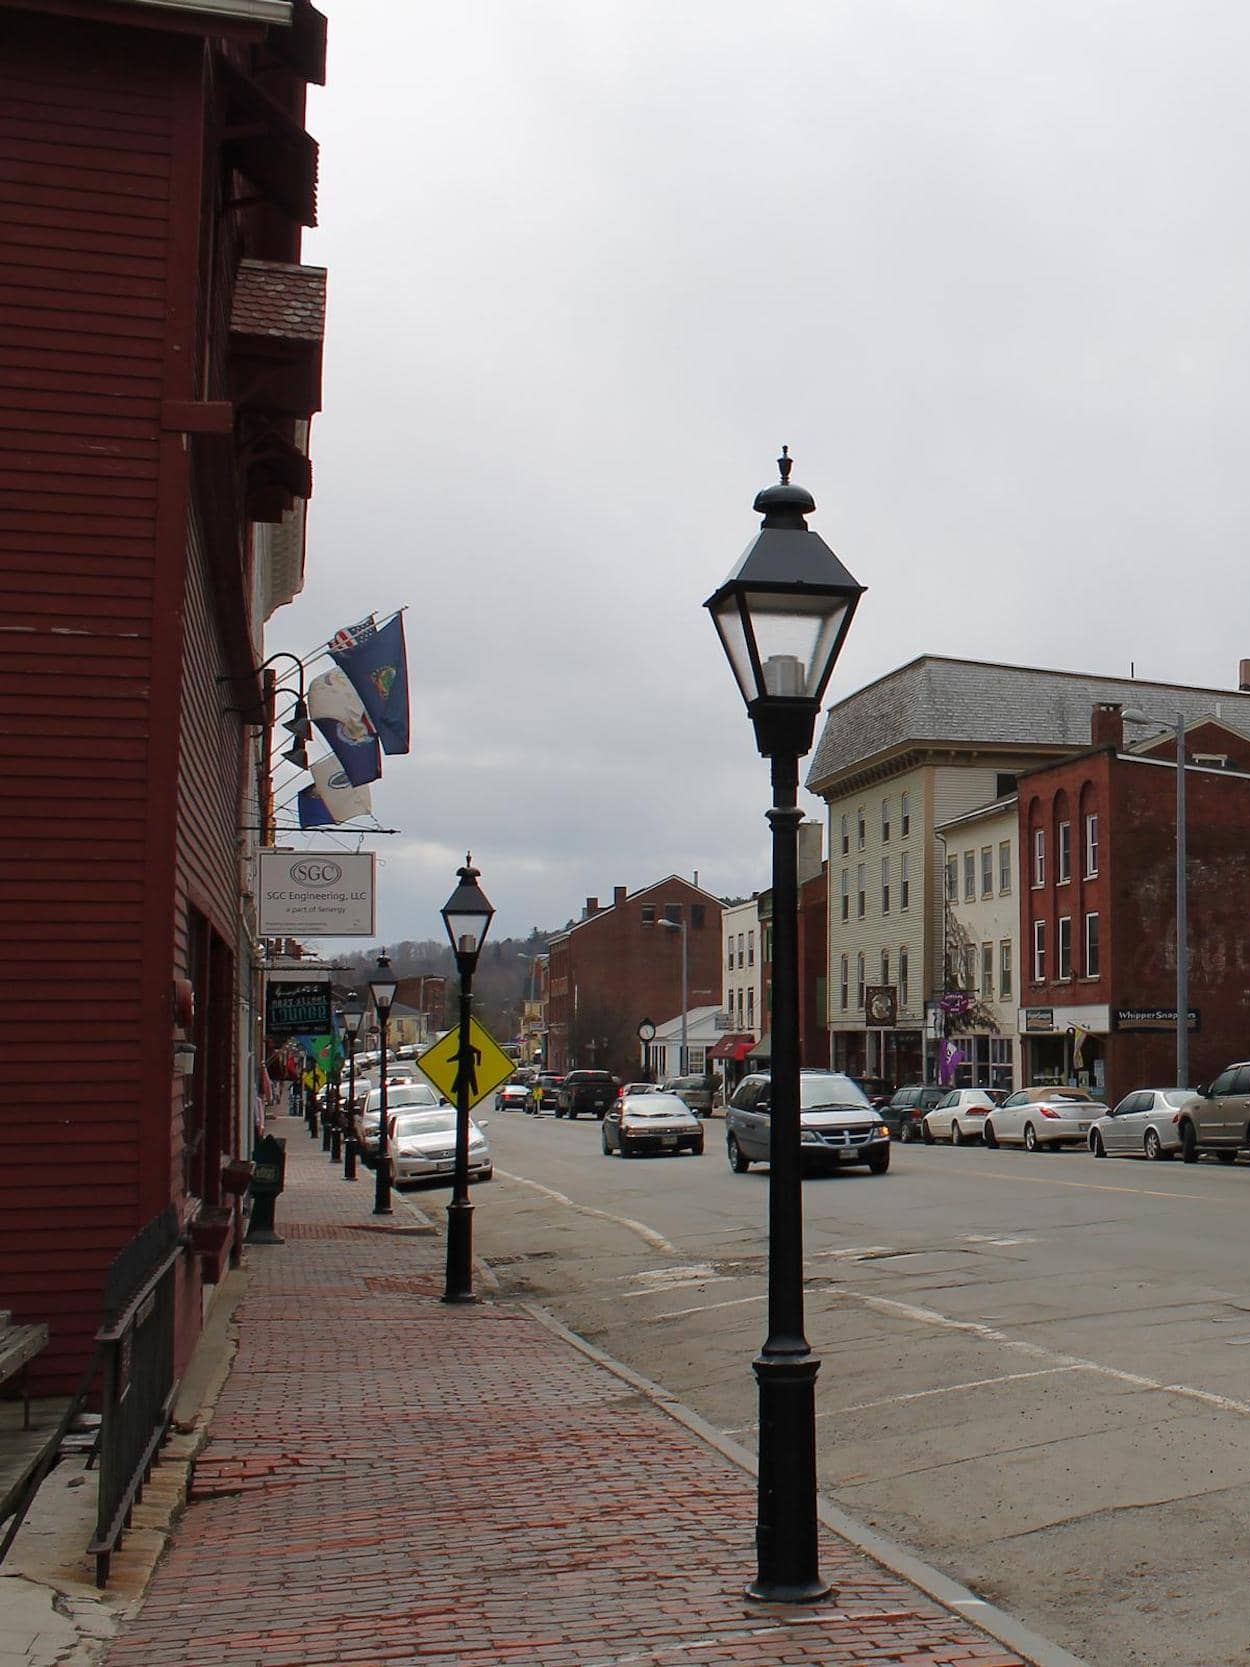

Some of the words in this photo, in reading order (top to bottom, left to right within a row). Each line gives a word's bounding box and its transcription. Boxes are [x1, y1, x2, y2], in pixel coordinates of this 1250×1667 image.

[298, 865, 335, 881] SGC
[266, 891, 287, 900] SGC
[289, 891, 348, 902] Engineering,
[351, 891, 367, 900] LLC
